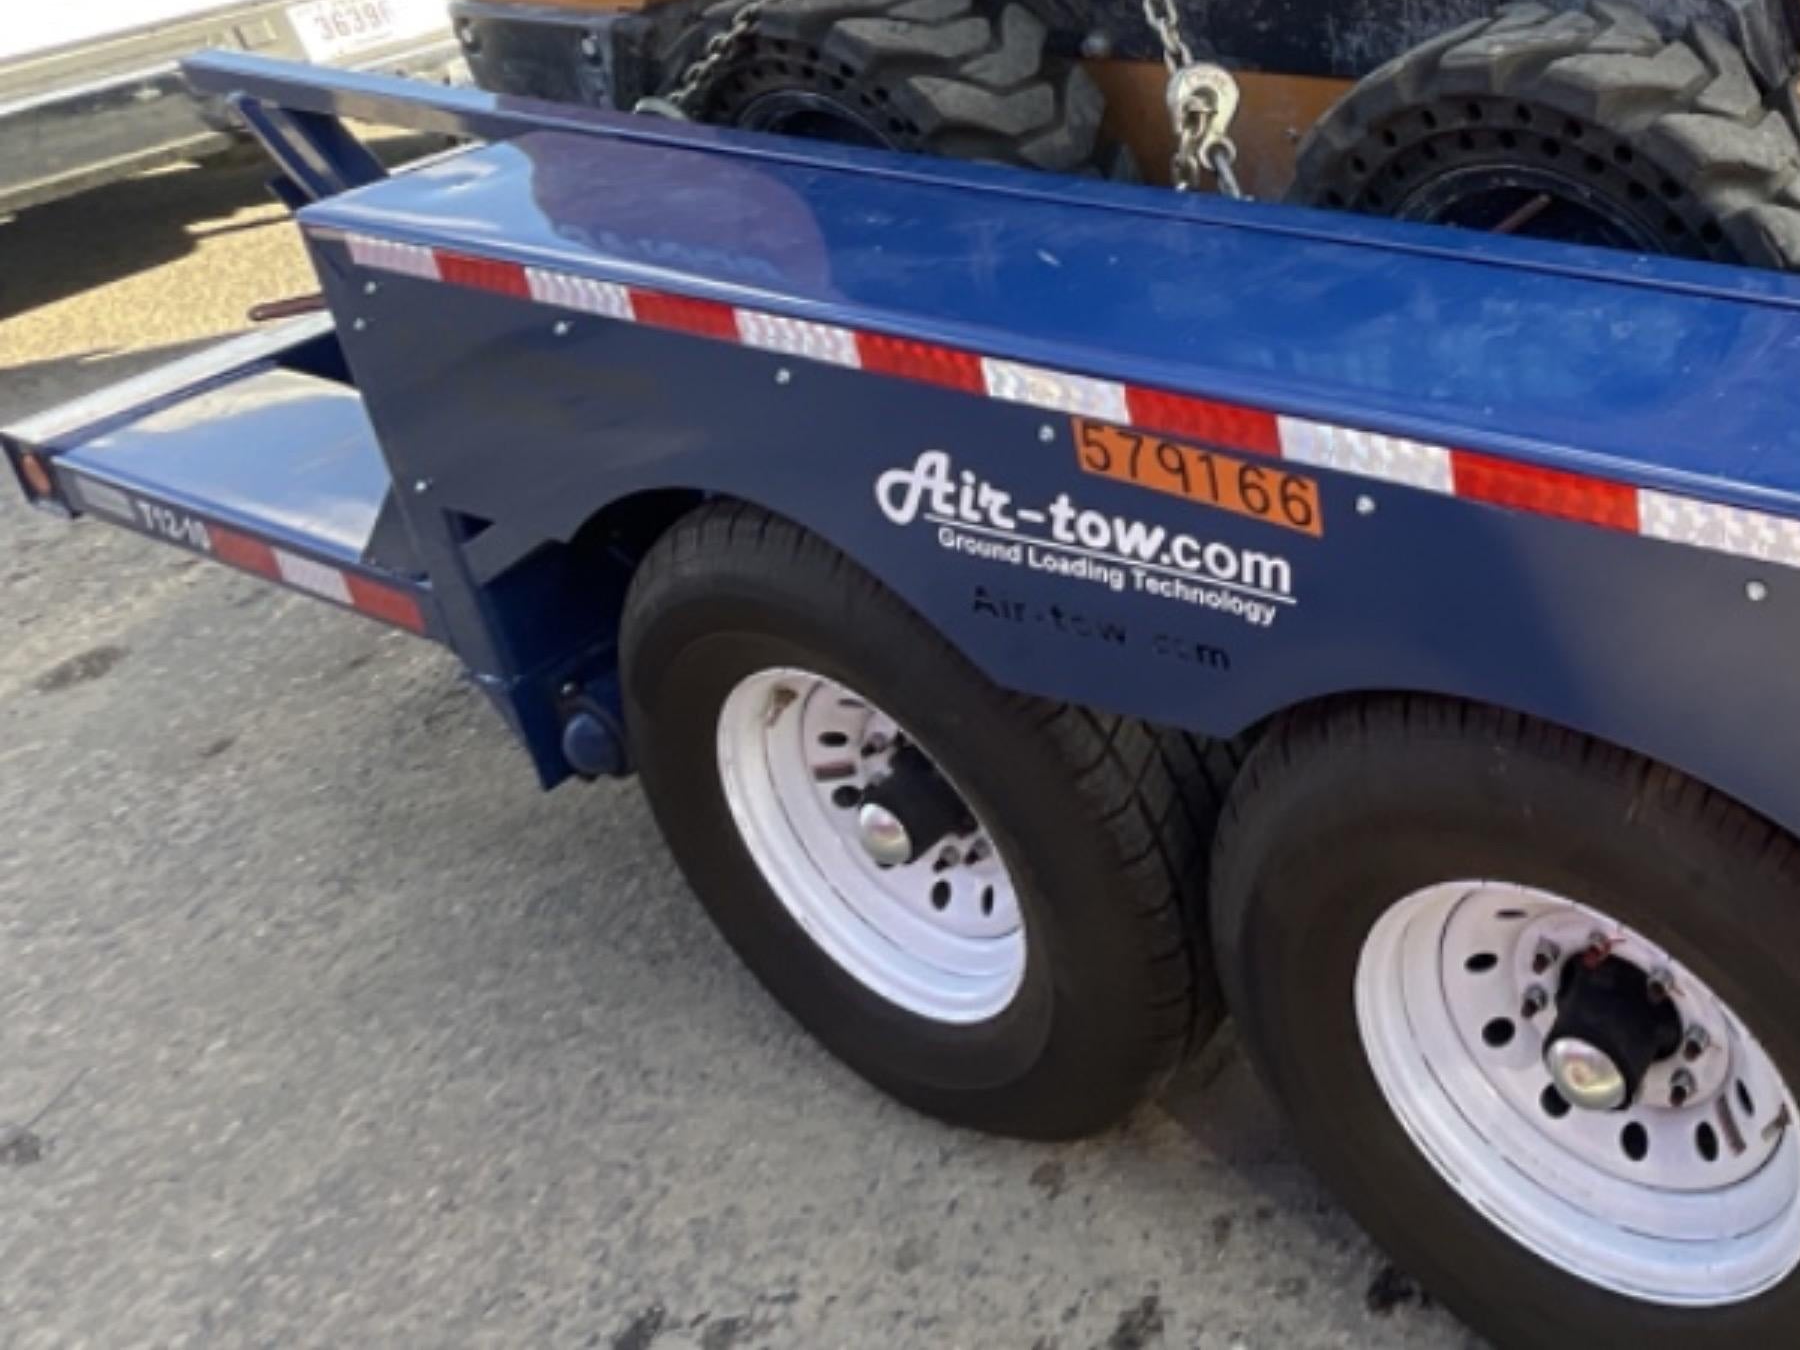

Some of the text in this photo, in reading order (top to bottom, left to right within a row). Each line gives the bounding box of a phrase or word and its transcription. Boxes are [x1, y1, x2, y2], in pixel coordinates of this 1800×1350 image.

[875, 449, 1293, 595] Air-tow.com
[1080, 423, 1314, 529] 579166
[938, 526, 1277, 628] Ground Loading Technology
